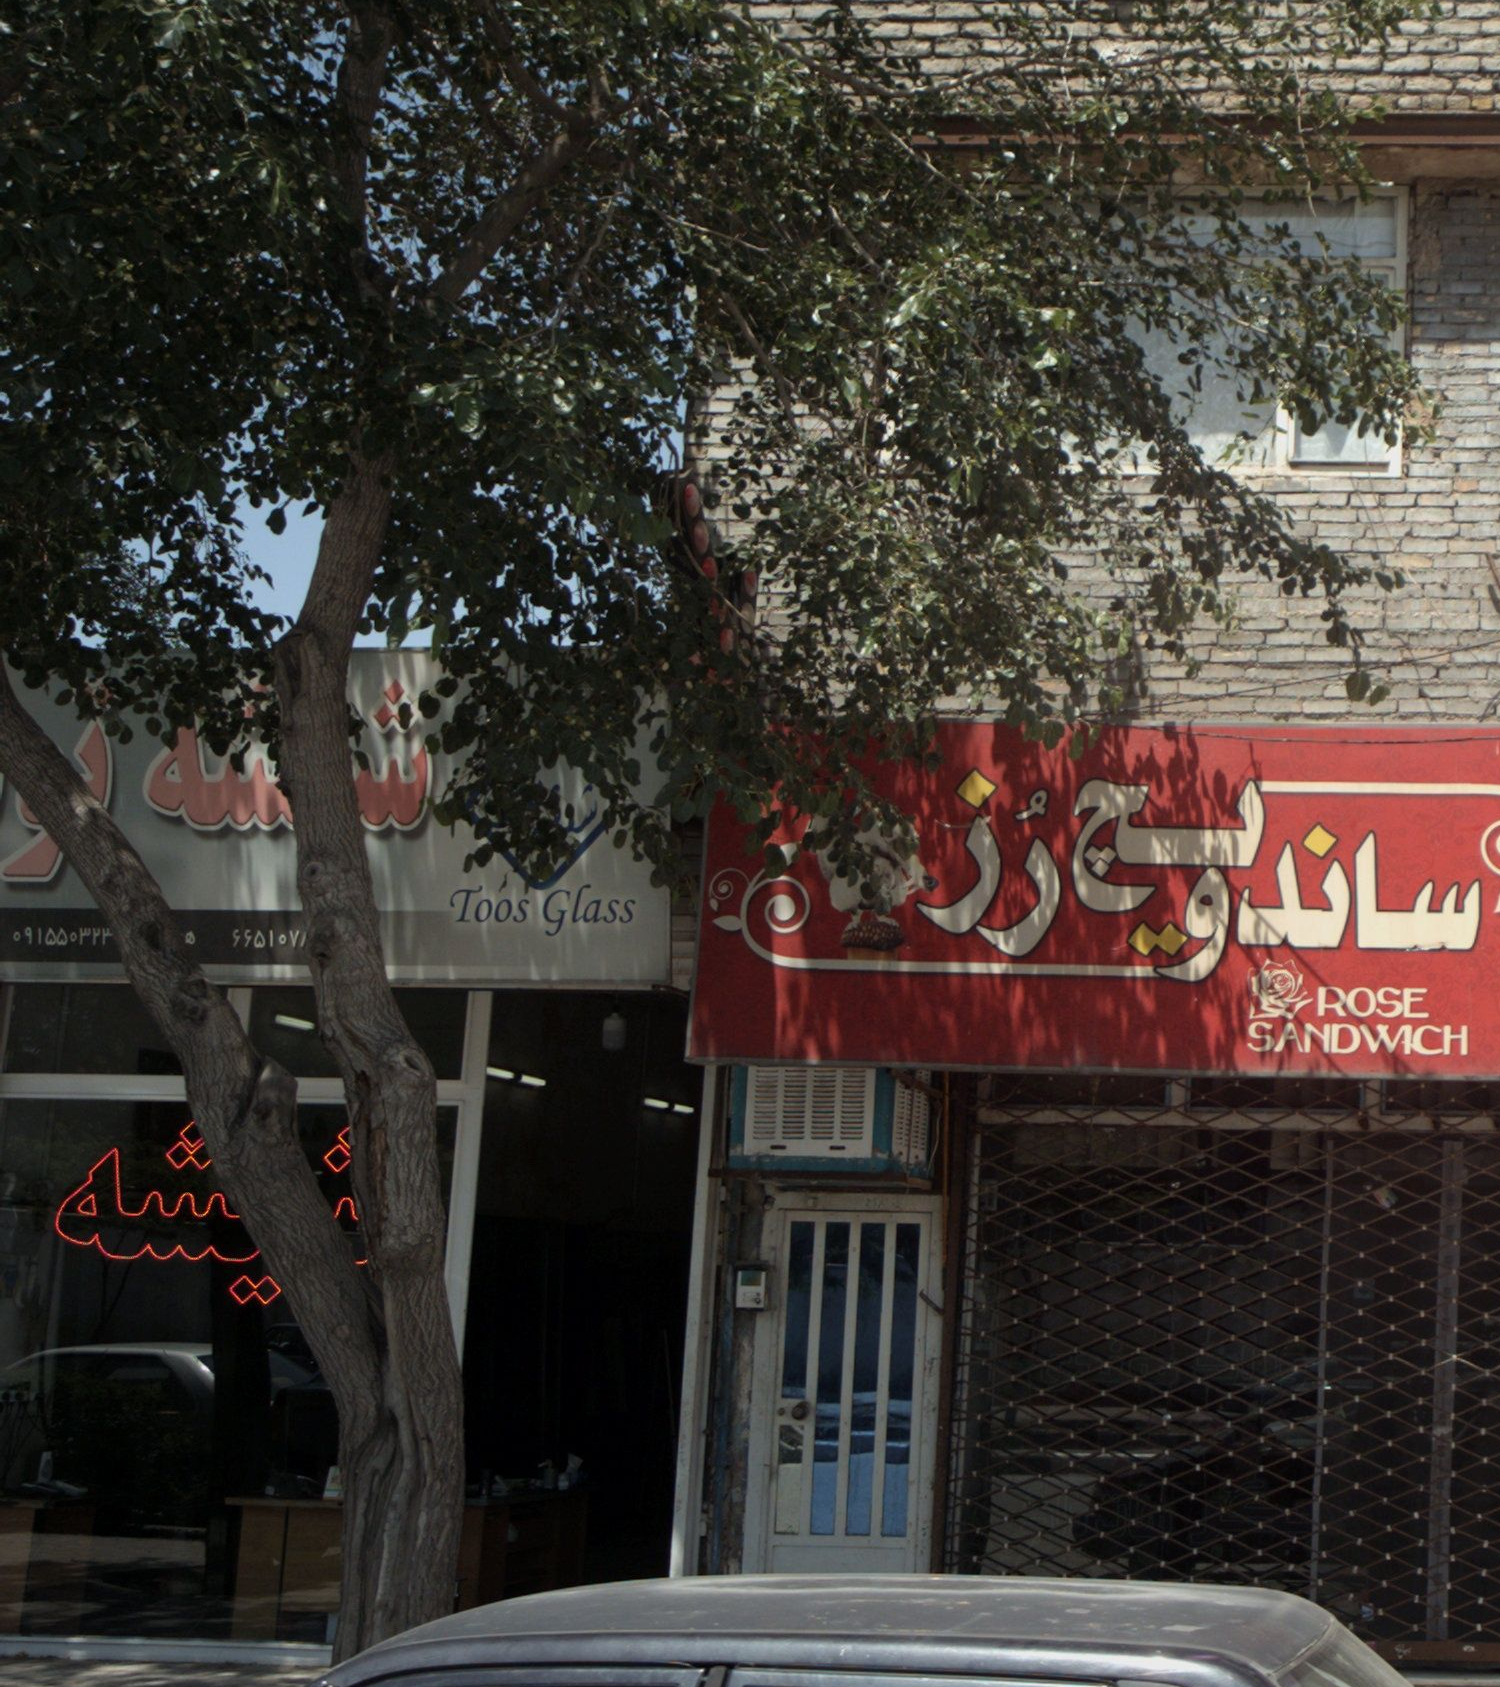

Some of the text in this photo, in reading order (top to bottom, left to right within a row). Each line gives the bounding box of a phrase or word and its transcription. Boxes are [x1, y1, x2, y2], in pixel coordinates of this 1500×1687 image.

[1070, 776, 1482, 984] ساندویچ
[450, 883, 637, 937] Toos Glass
[1317, 986, 1429, 1019] ROSE
[1247, 1022, 1470, 1057] SANDWICH
